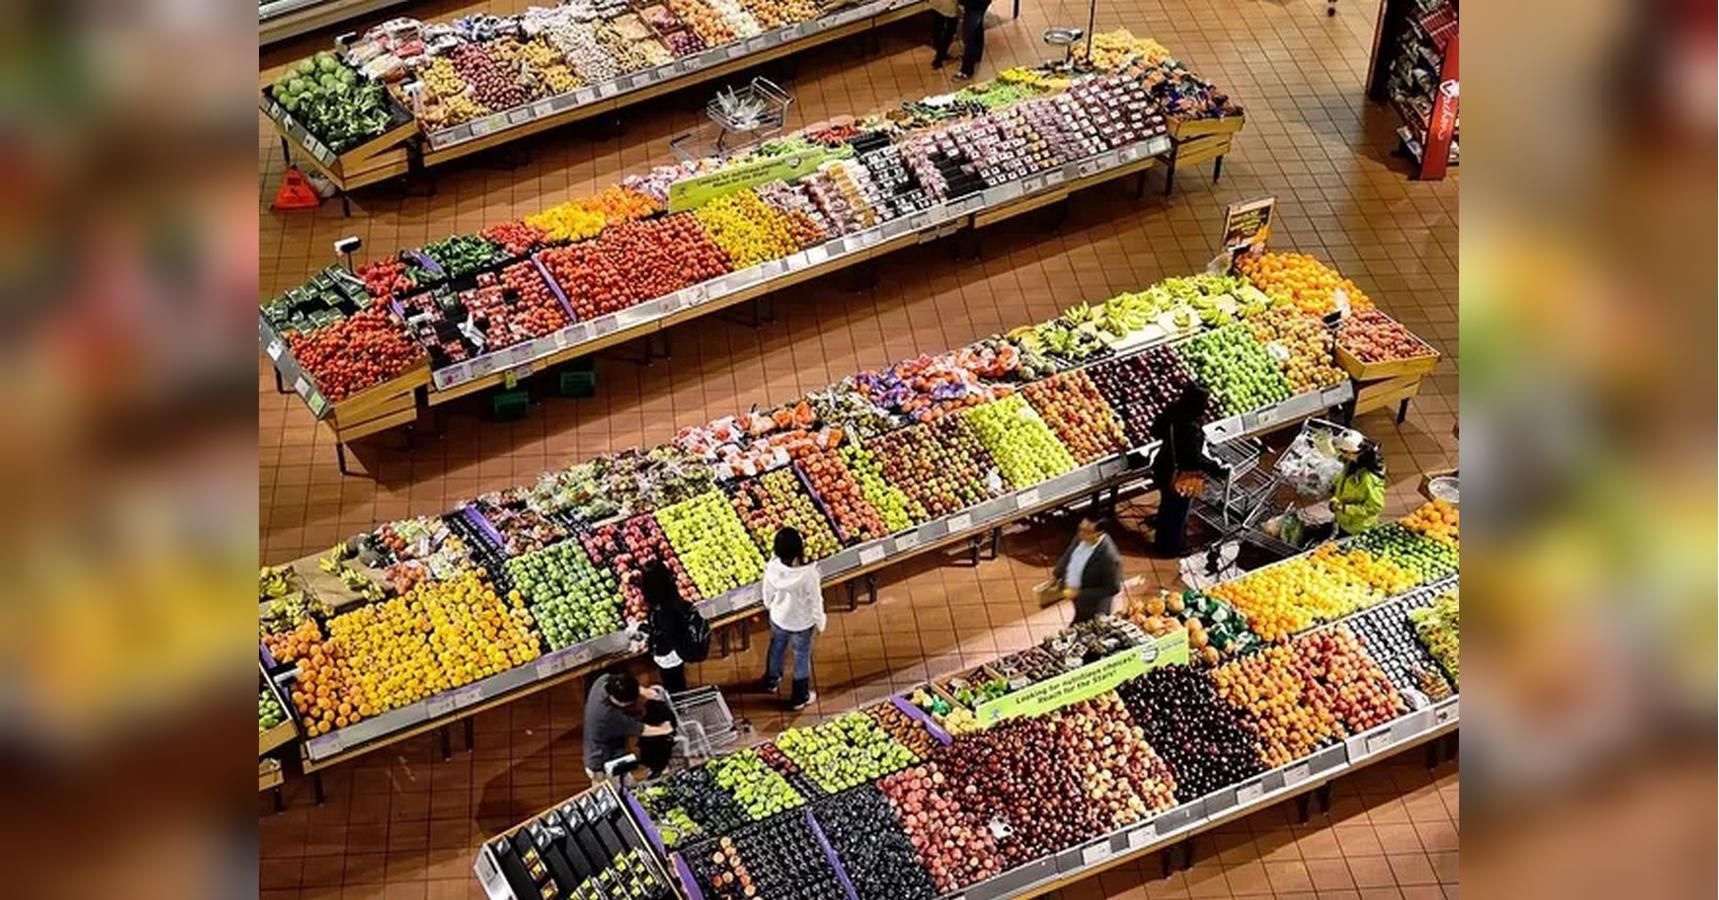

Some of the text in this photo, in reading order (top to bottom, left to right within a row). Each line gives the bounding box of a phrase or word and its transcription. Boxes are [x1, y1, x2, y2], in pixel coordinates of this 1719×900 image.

[1015, 687, 1048, 705] Looking
[1048, 682, 1061, 692] for
[1061, 668, 1102, 687] nutritious
[1037, 689, 1063, 704] Reach
[1063, 685, 1076, 695] for
[1076, 679, 1091, 690] the
